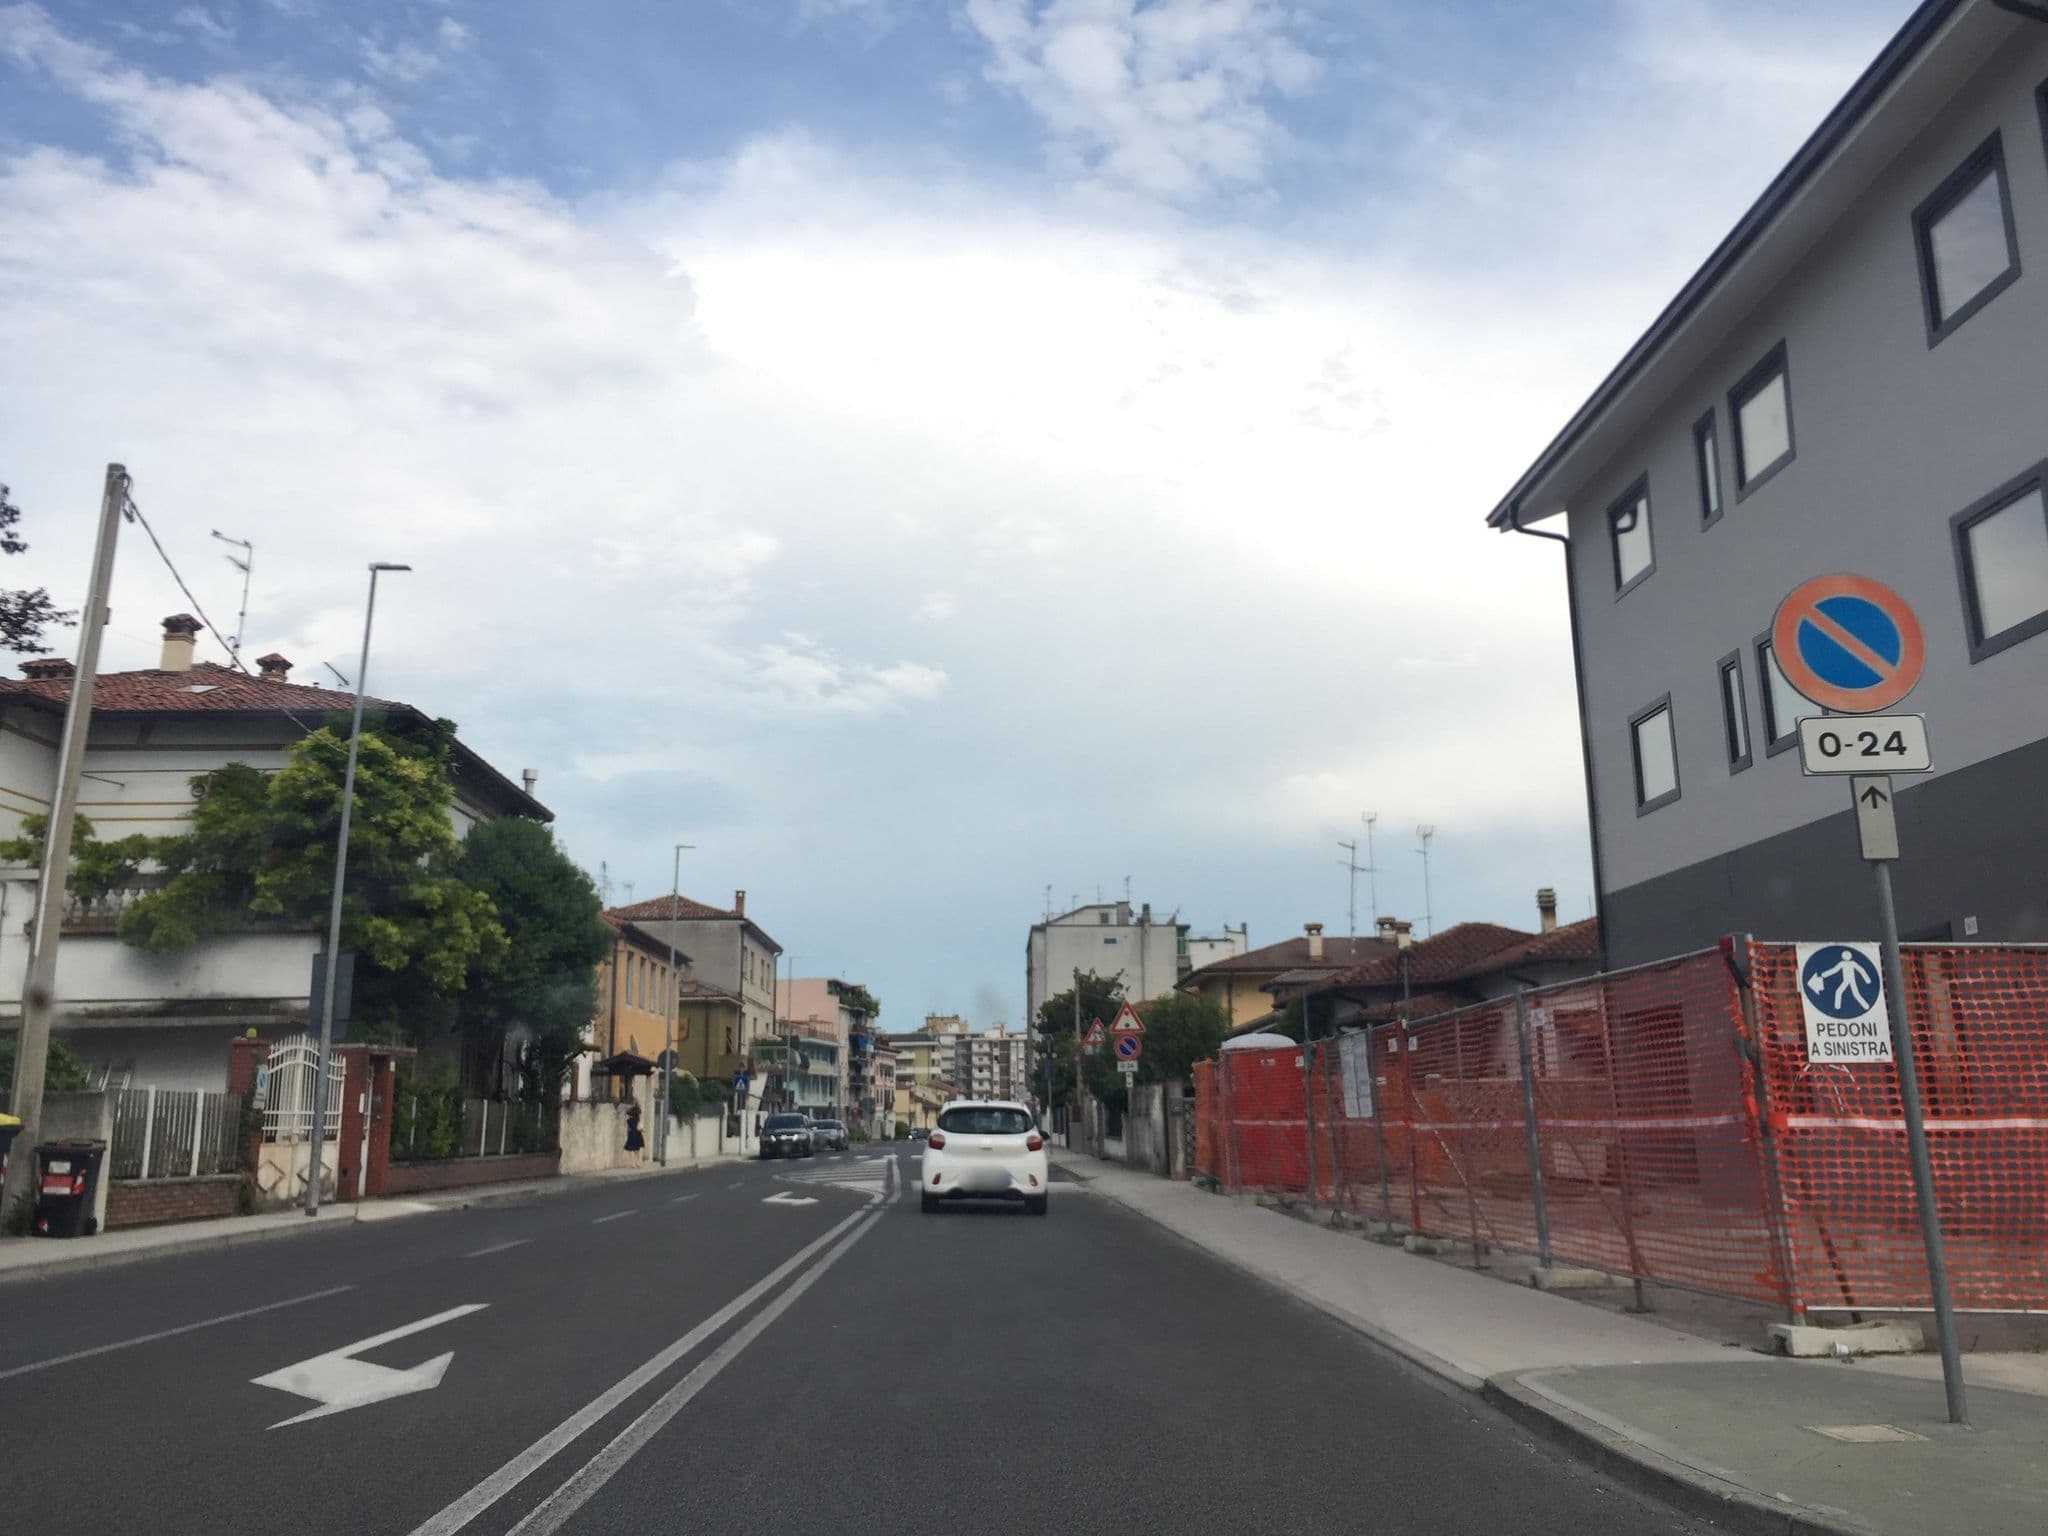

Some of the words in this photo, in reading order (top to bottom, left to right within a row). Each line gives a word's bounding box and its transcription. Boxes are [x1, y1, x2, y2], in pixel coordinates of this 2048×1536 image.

[1818, 731, 1907, 758] 0-24
[1816, 1022, 1878, 1037] PEDONI
[1811, 1042, 1820, 1056] A
[1823, 1041, 1889, 1056] SINISTRA
